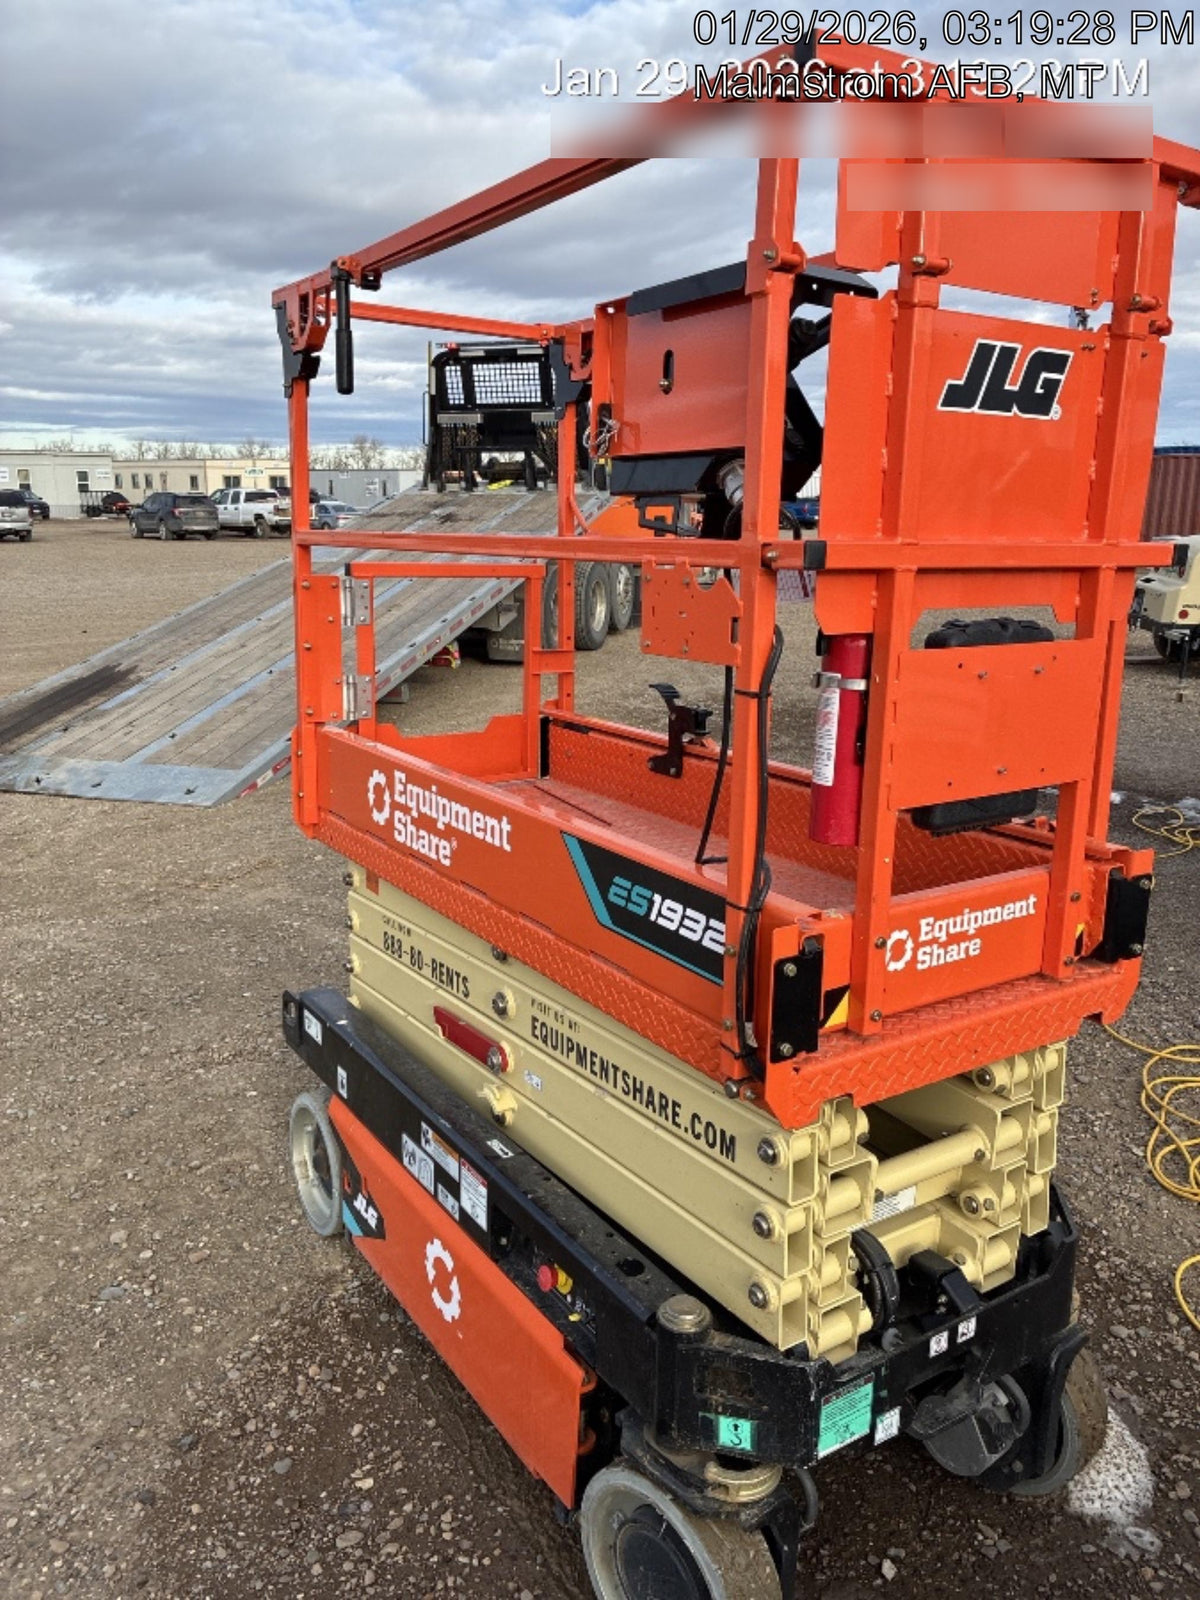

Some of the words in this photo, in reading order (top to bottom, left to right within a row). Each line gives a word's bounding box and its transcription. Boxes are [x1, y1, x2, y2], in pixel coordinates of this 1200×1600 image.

[937, 338, 1074, 420] JLG
[394, 769, 512, 852] Equipment
[608, 876, 726, 955] ES1932
[916, 938, 982, 970] Share
[919, 893, 1038, 942] Equipment
[531, 1016, 737, 1163] EQUIPMENTSHARE.COM
[353, 1192, 378, 1230] JLG
